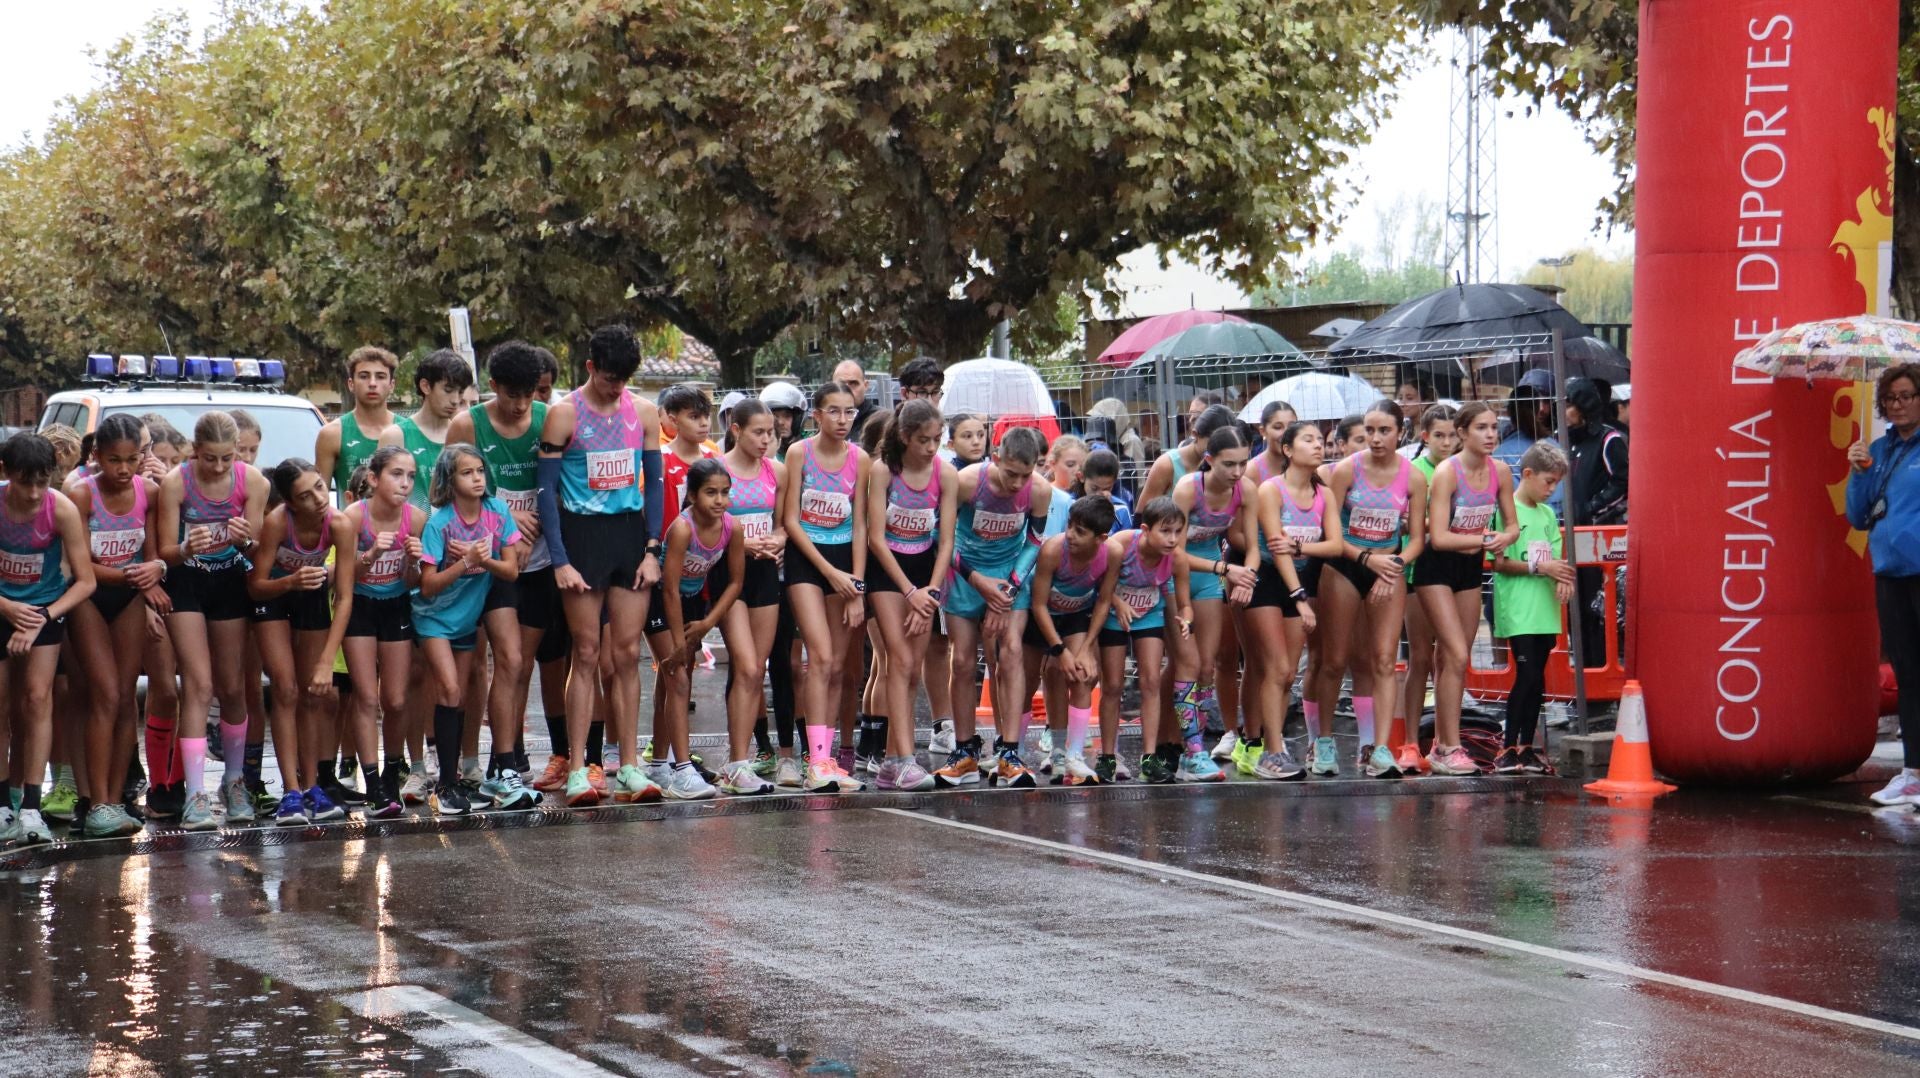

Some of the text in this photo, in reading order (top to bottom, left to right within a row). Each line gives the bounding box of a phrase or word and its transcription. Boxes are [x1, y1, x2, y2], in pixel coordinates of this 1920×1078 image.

[1735, 15, 1794, 291] DEPORTES
[596, 459, 628, 477] 2007
[506, 497, 534, 512] 2012
[810, 498, 843, 517] 2044
[892, 514, 927, 531] 2053
[981, 518, 1015, 532] 2006
[1358, 515, 1391, 531] 2048
[101, 539, 136, 556] 2042
[1715, 409, 1775, 741] CONCEJALÍA
[1122, 592, 1153, 608] 2004
